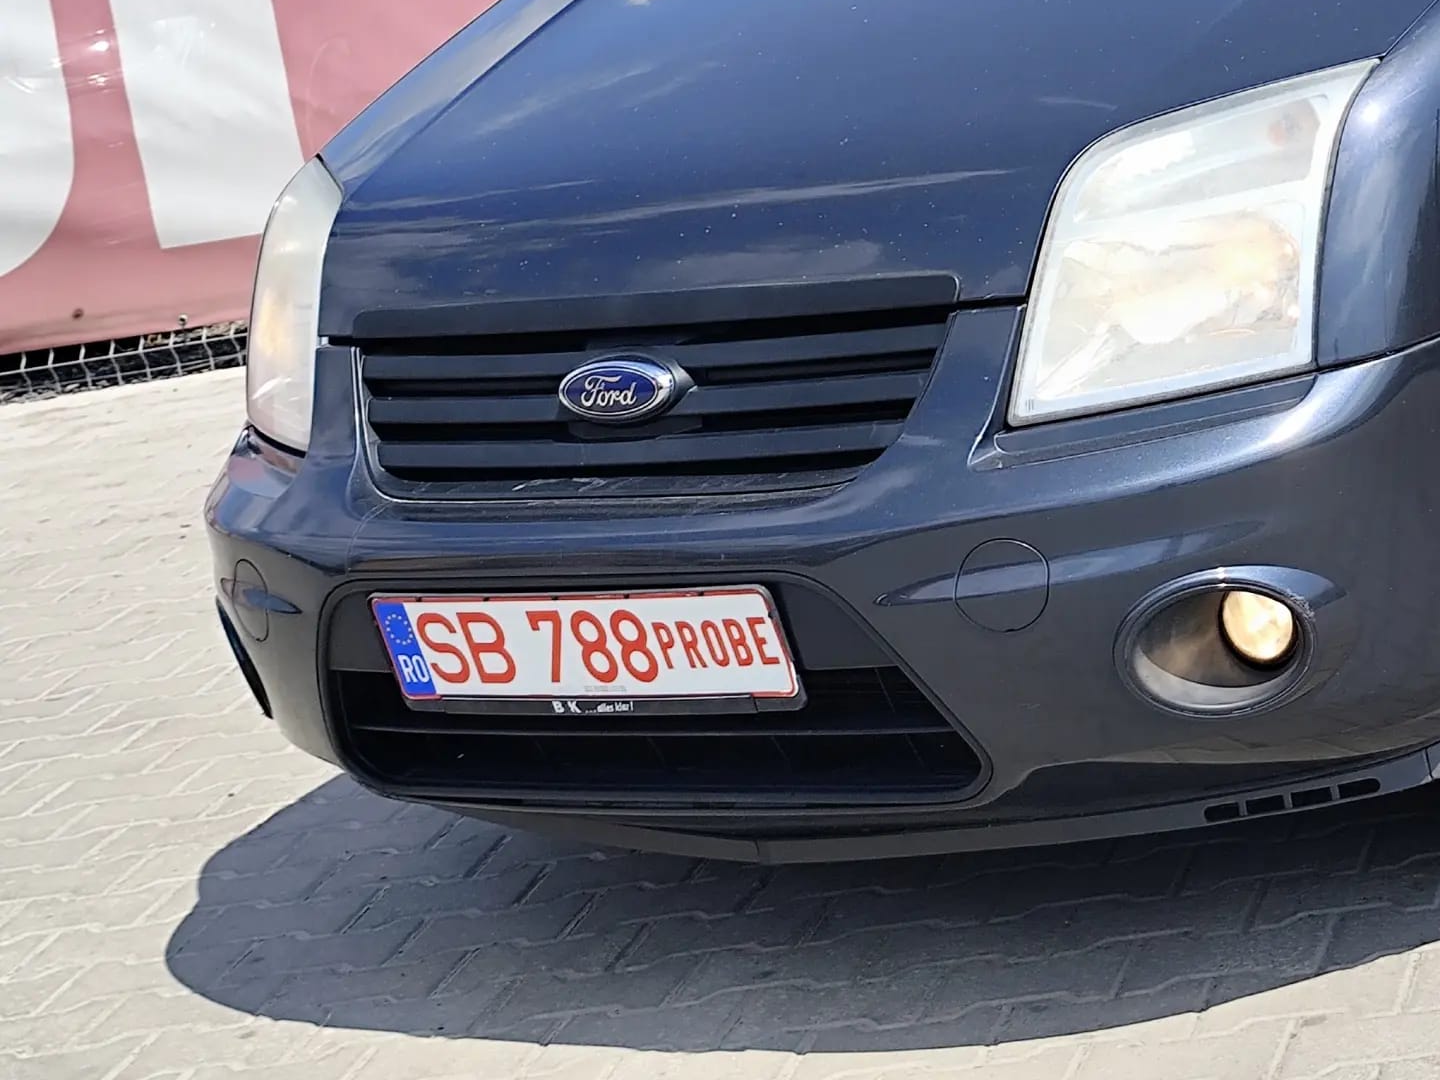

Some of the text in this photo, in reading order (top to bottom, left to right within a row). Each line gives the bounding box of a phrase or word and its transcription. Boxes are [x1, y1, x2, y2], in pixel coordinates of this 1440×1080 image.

[580, 374, 637, 407] Ford
[416, 609, 781, 684] SB 788 PROBE
[397, 654, 431, 684] RO
